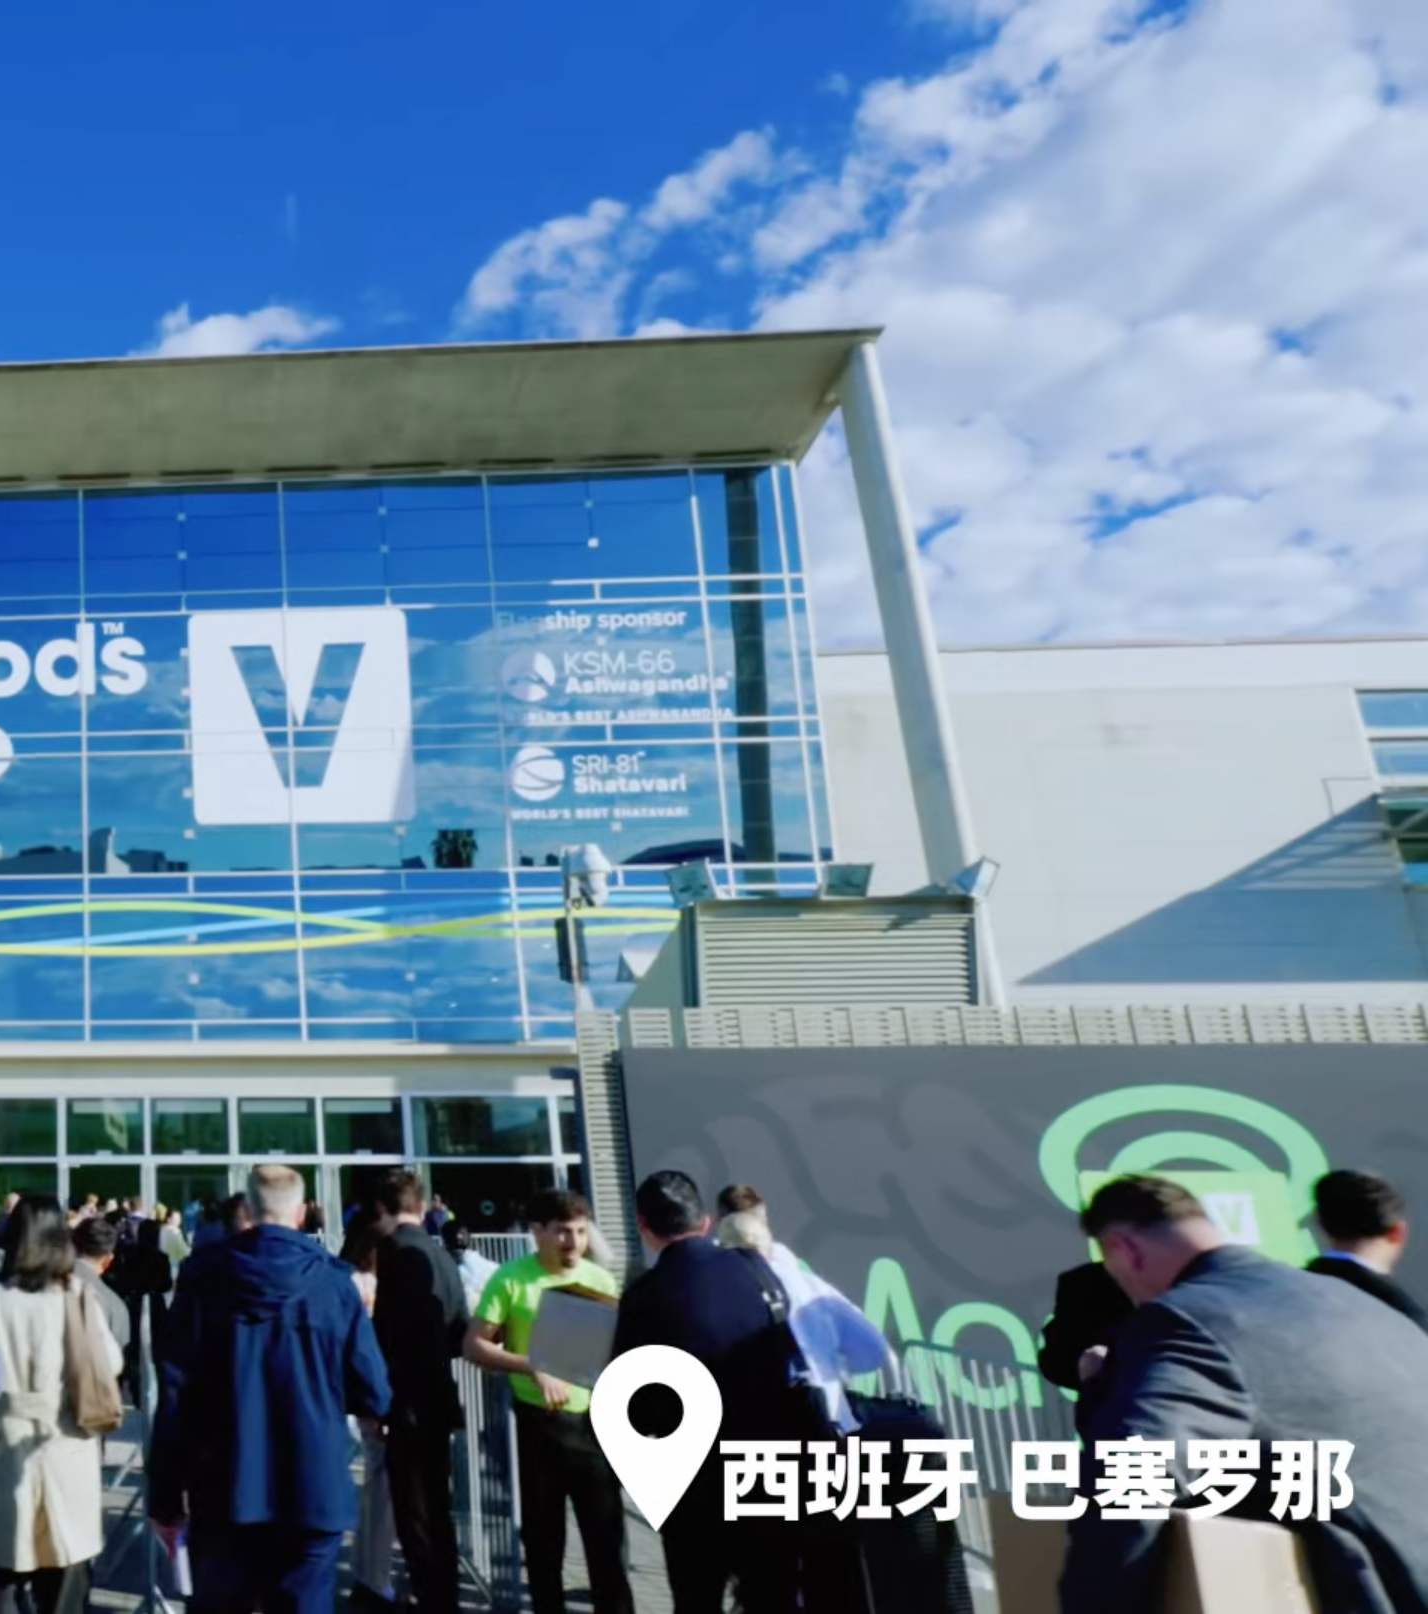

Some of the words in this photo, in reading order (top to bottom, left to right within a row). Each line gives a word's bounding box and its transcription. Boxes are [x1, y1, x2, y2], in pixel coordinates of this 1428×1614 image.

[598, 611, 687, 631] sponsor
[564, 650, 675, 675] KSM-66
[574, 775, 686, 794] Shatavari
[576, 808, 609, 819] BEST
